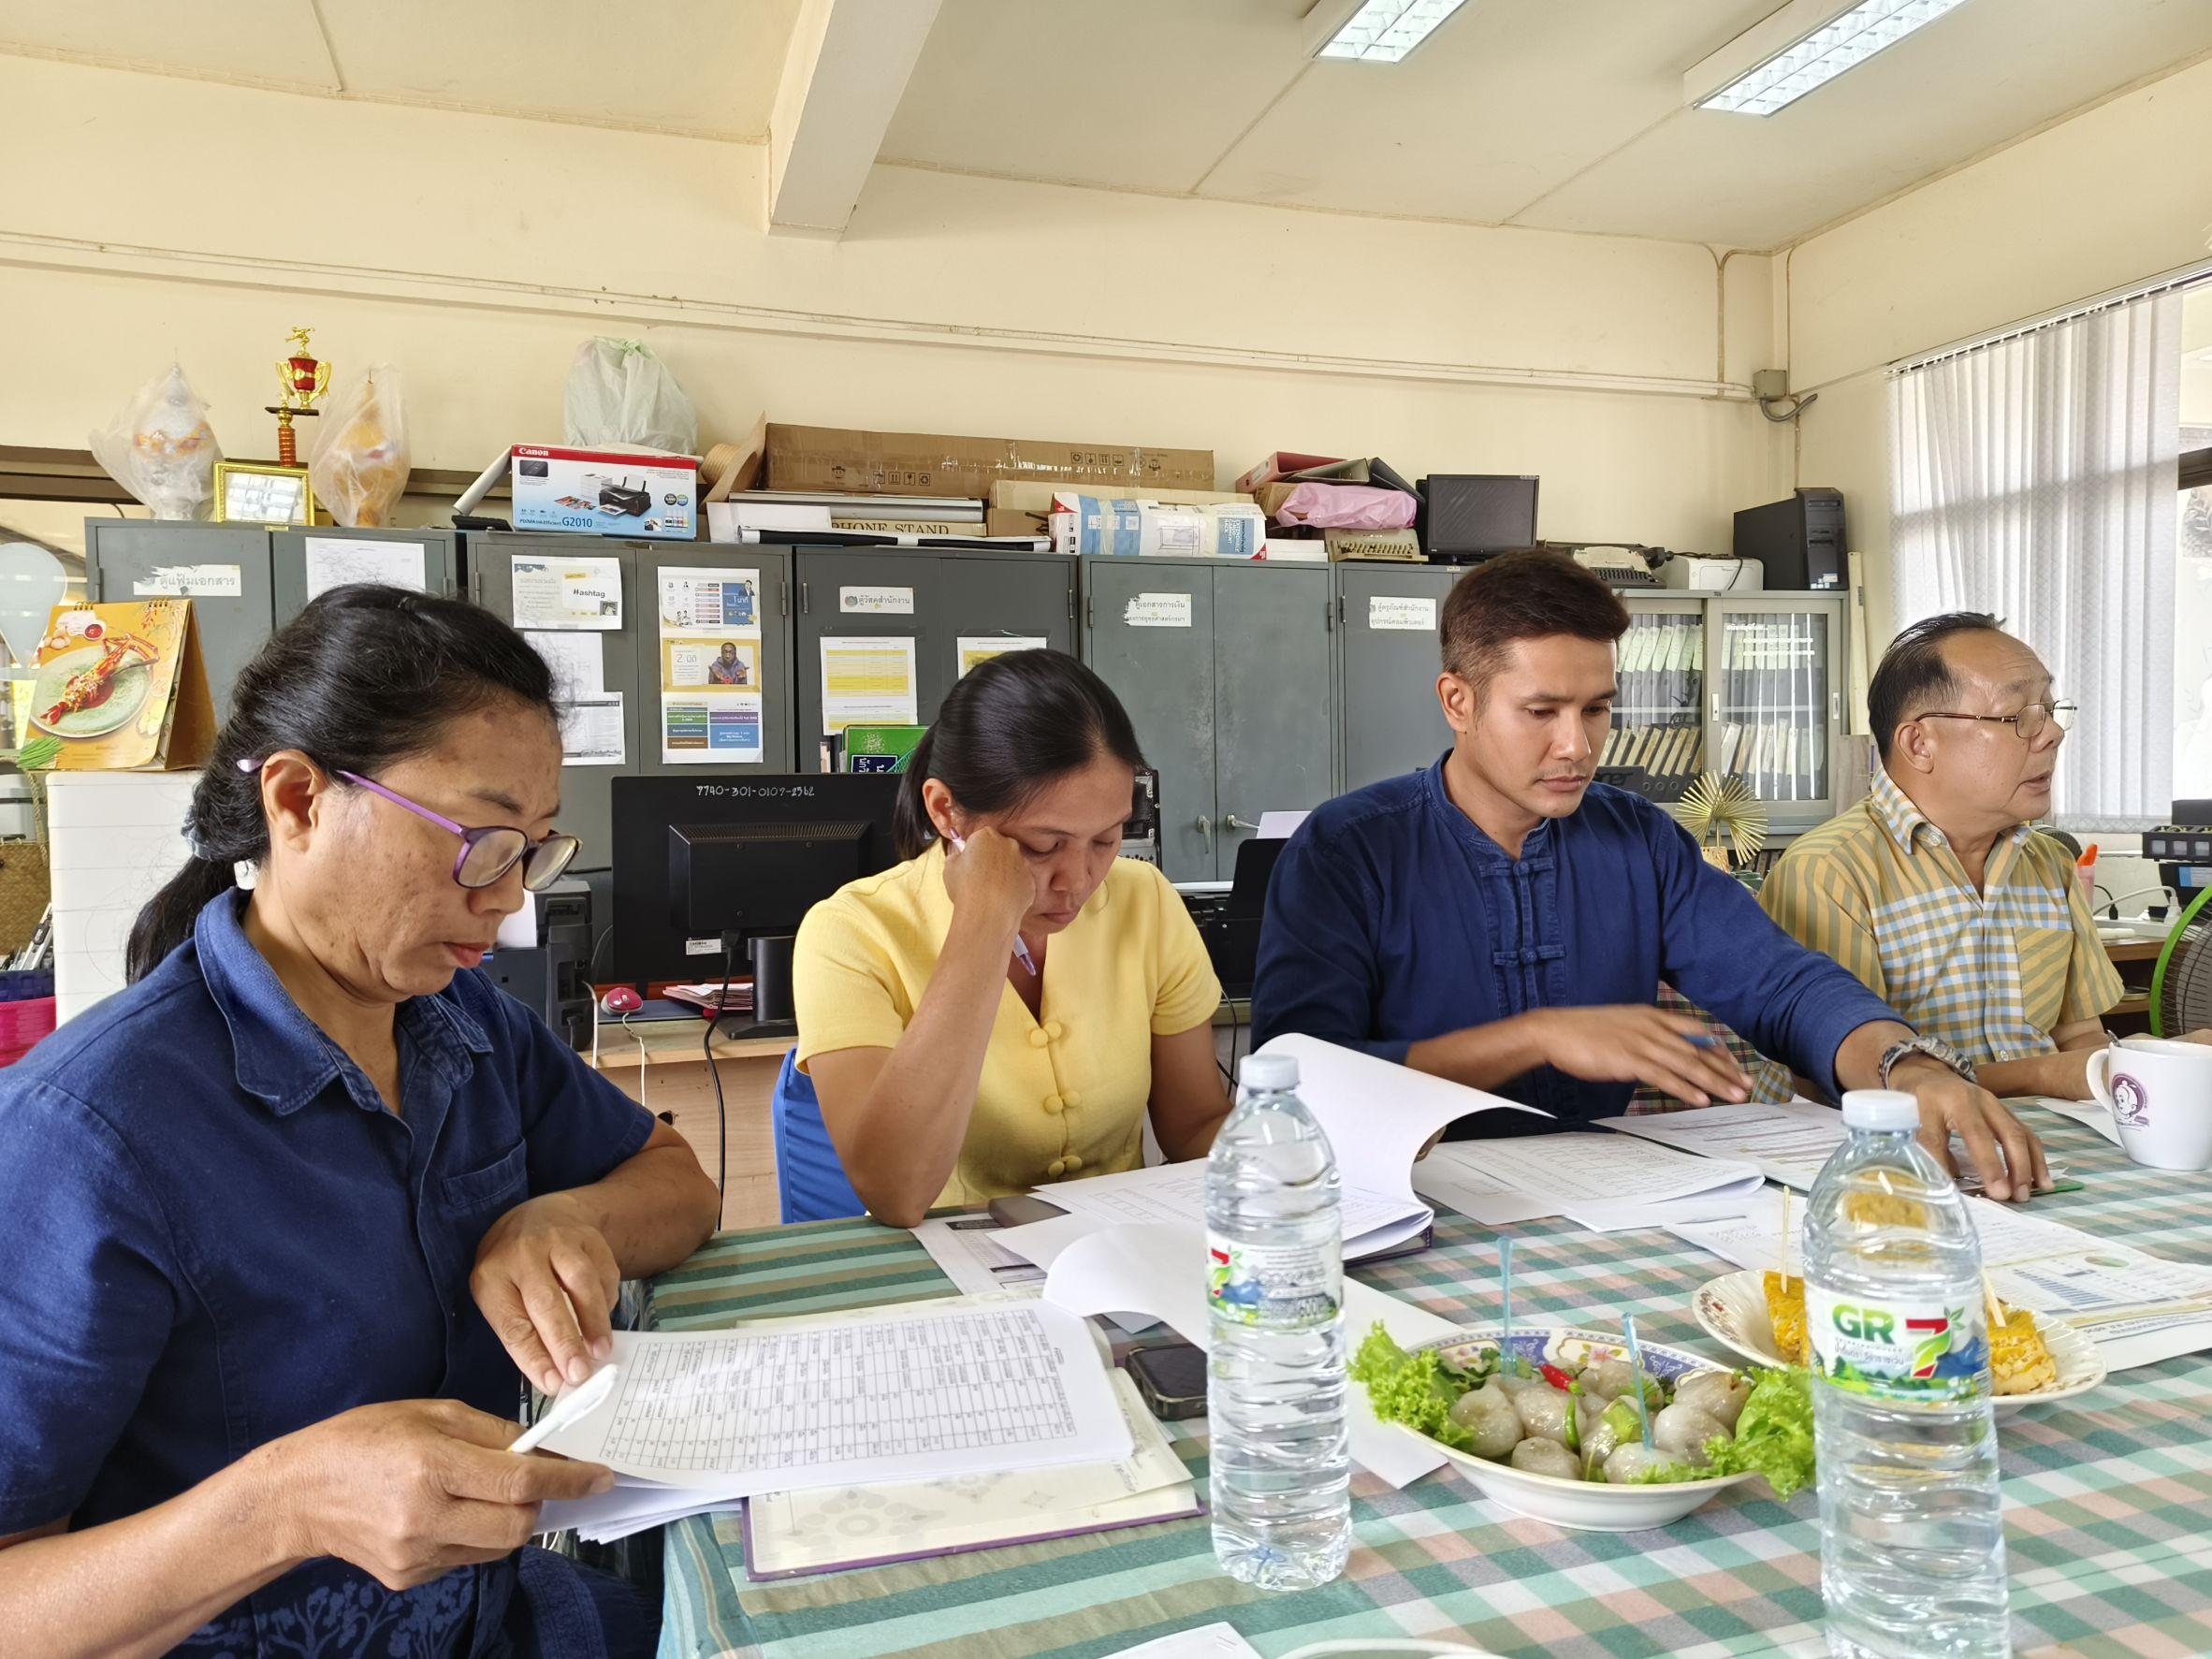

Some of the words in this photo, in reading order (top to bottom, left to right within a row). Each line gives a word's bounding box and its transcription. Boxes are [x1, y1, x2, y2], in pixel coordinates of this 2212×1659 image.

[518, 447, 549, 457] Canon
[562, 516, 592, 528] G2010
[895, 524, 950, 535] STAND
[696, 784, 815, 797] 7740-301-0107-2562
[1832, 1303, 1895, 1345] GR
[1905, 1317, 1949, 1379] 7
